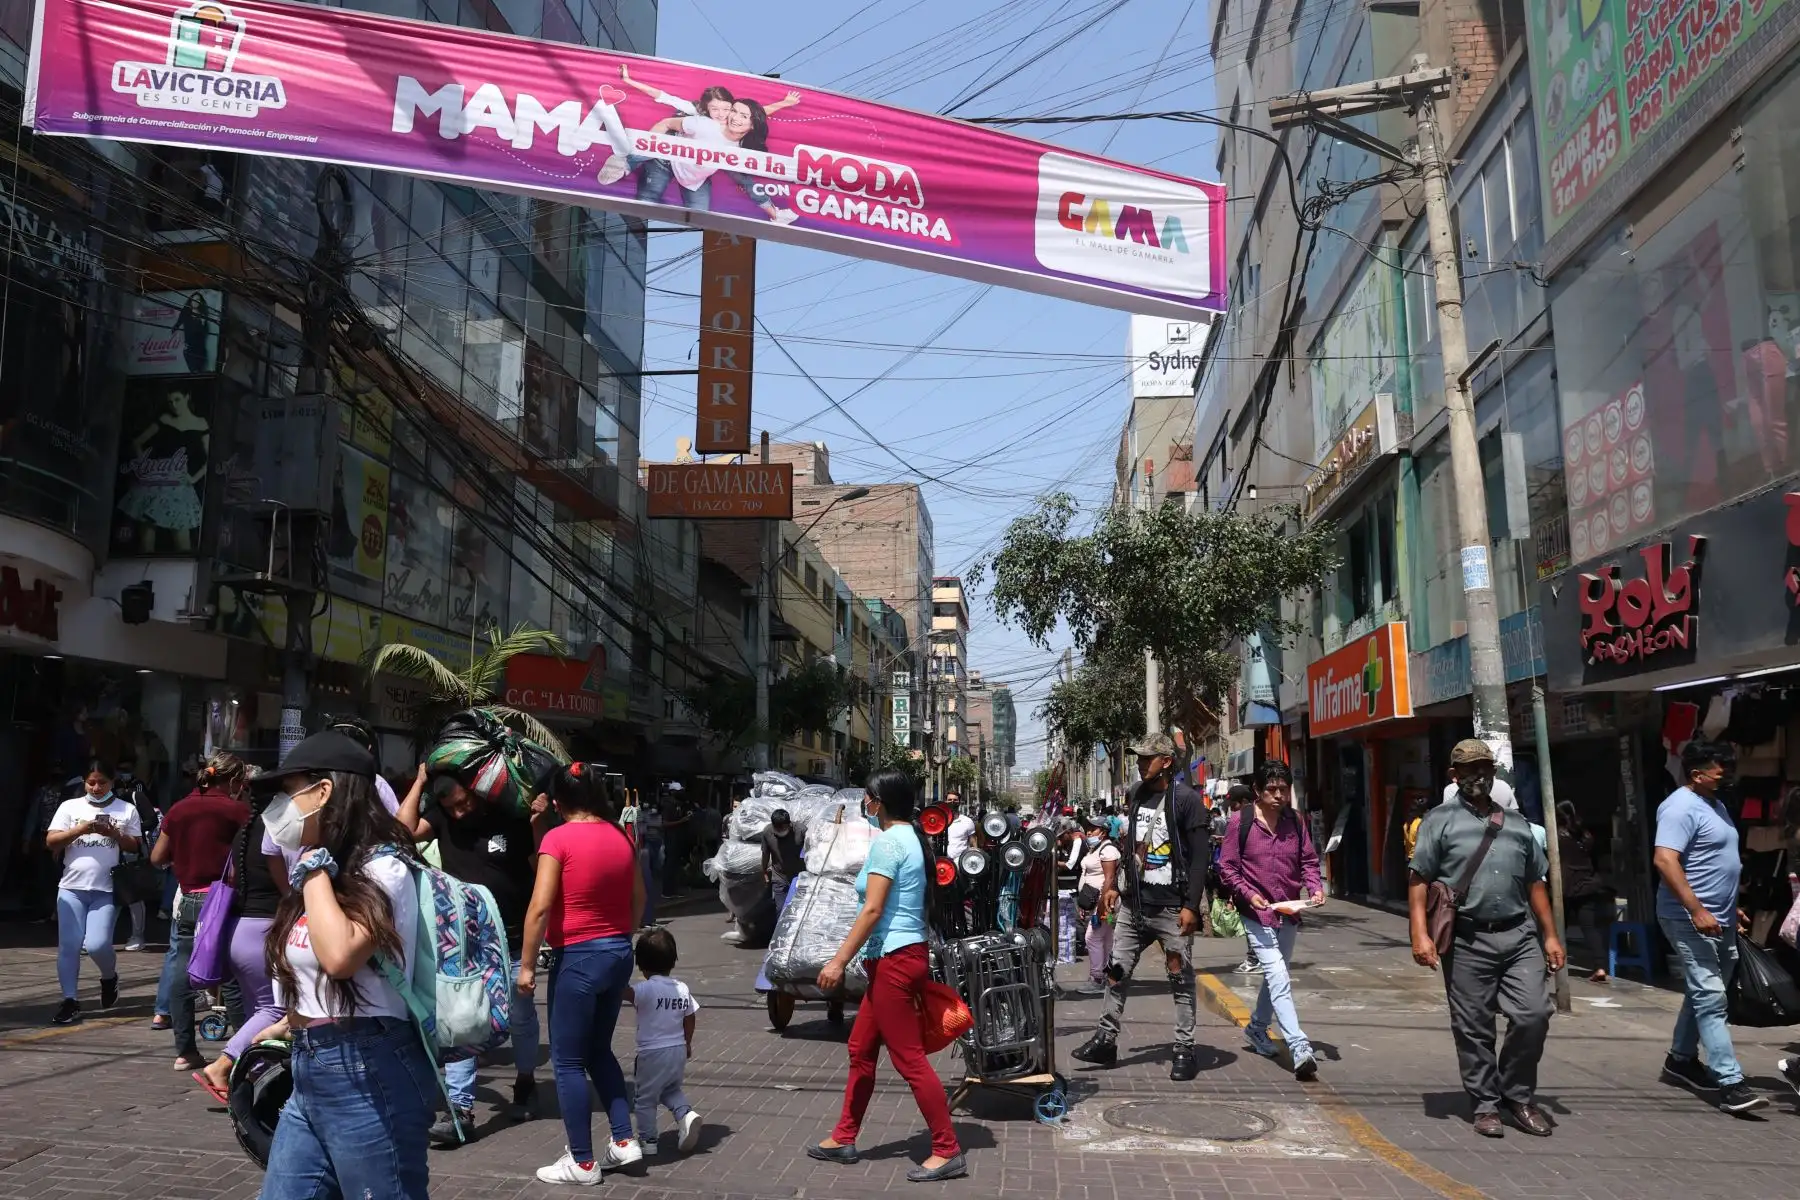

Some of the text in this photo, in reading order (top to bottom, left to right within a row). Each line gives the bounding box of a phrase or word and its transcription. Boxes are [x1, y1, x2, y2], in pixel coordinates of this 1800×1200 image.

[1624, 30, 1644, 72] DE
[1626, 35, 1674, 110] PARA
[1629, 1, 1742, 146] POR MAYOR
[72, 111, 318, 143] Subgerencia de Comercialización y Promoción Empresarial
[143, 92, 253, 112] ES SU GENTE
[635, 134, 786, 176] siempre a la
[1551, 121, 1591, 188] SUBIR
[1596, 96, 1617, 140] AL
[1581, 128, 1617, 188] PISO
[796, 148, 921, 207] MODA
[752, 182, 952, 242] CON GAMARRA
[1057, 191, 1190, 254] GAMA
[1075, 237, 1175, 265] EL MALL DE GAMARRA
[709, 274, 742, 444] TORRE
[653, 469, 785, 495] DE GAMARRA
[692, 500, 733, 511] BAZO
[740, 500, 763, 511] 709
[505, 688, 537, 706] C.C.
[1313, 667, 1361, 723] Mifarma
